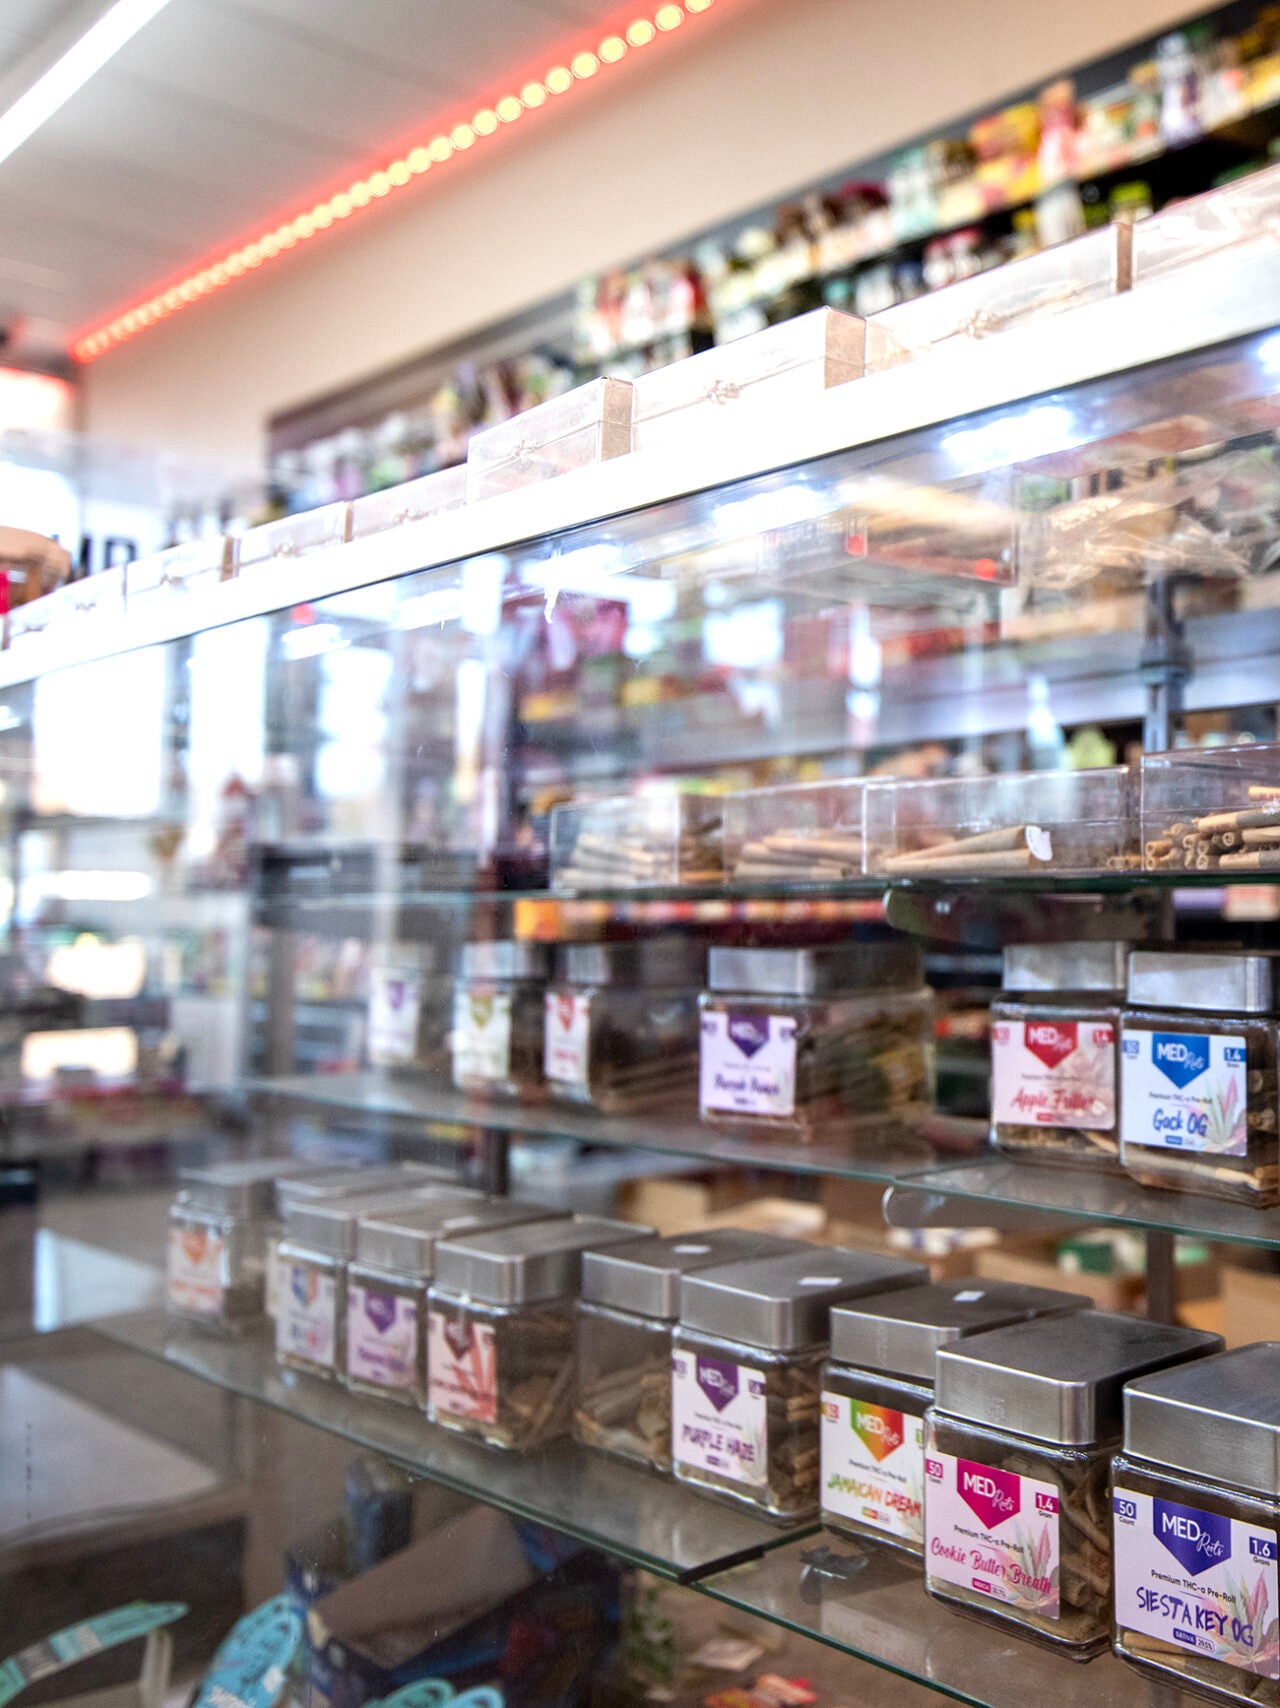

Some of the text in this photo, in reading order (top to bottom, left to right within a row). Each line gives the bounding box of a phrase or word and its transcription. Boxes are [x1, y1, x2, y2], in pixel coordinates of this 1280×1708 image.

[1029, 1027, 1058, 1045] MED
[1157, 1043, 1187, 1062] MED
[1226, 1048, 1241, 1061] 1.4
[1153, 1108, 1208, 1137] Gack OG
[856, 1412, 885, 1435] MED
[928, 1462, 941, 1476] 50
[963, 1472, 996, 1498] MED
[827, 1473, 882, 1502] JAMAICAN
[884, 1491, 922, 1519] DREAM
[1037, 1495, 1054, 1511] 1.4
[1119, 1502, 1134, 1517] 50
[1118, 1516, 1136, 1526] Count
[1162, 1512, 1224, 1557] MED Roots
[1252, 1539, 1271, 1557] 1.6
[931, 1537, 967, 1565] Cookie
[970, 1550, 1007, 1578] Butter
[1009, 1564, 1053, 1594] Breath
[1252, 1556, 1271, 1567] Gram
[1151, 1569, 1237, 1604] Premium THC-a Pre-Roll
[1136, 1586, 1255, 1648] SIESTA KEY OG
